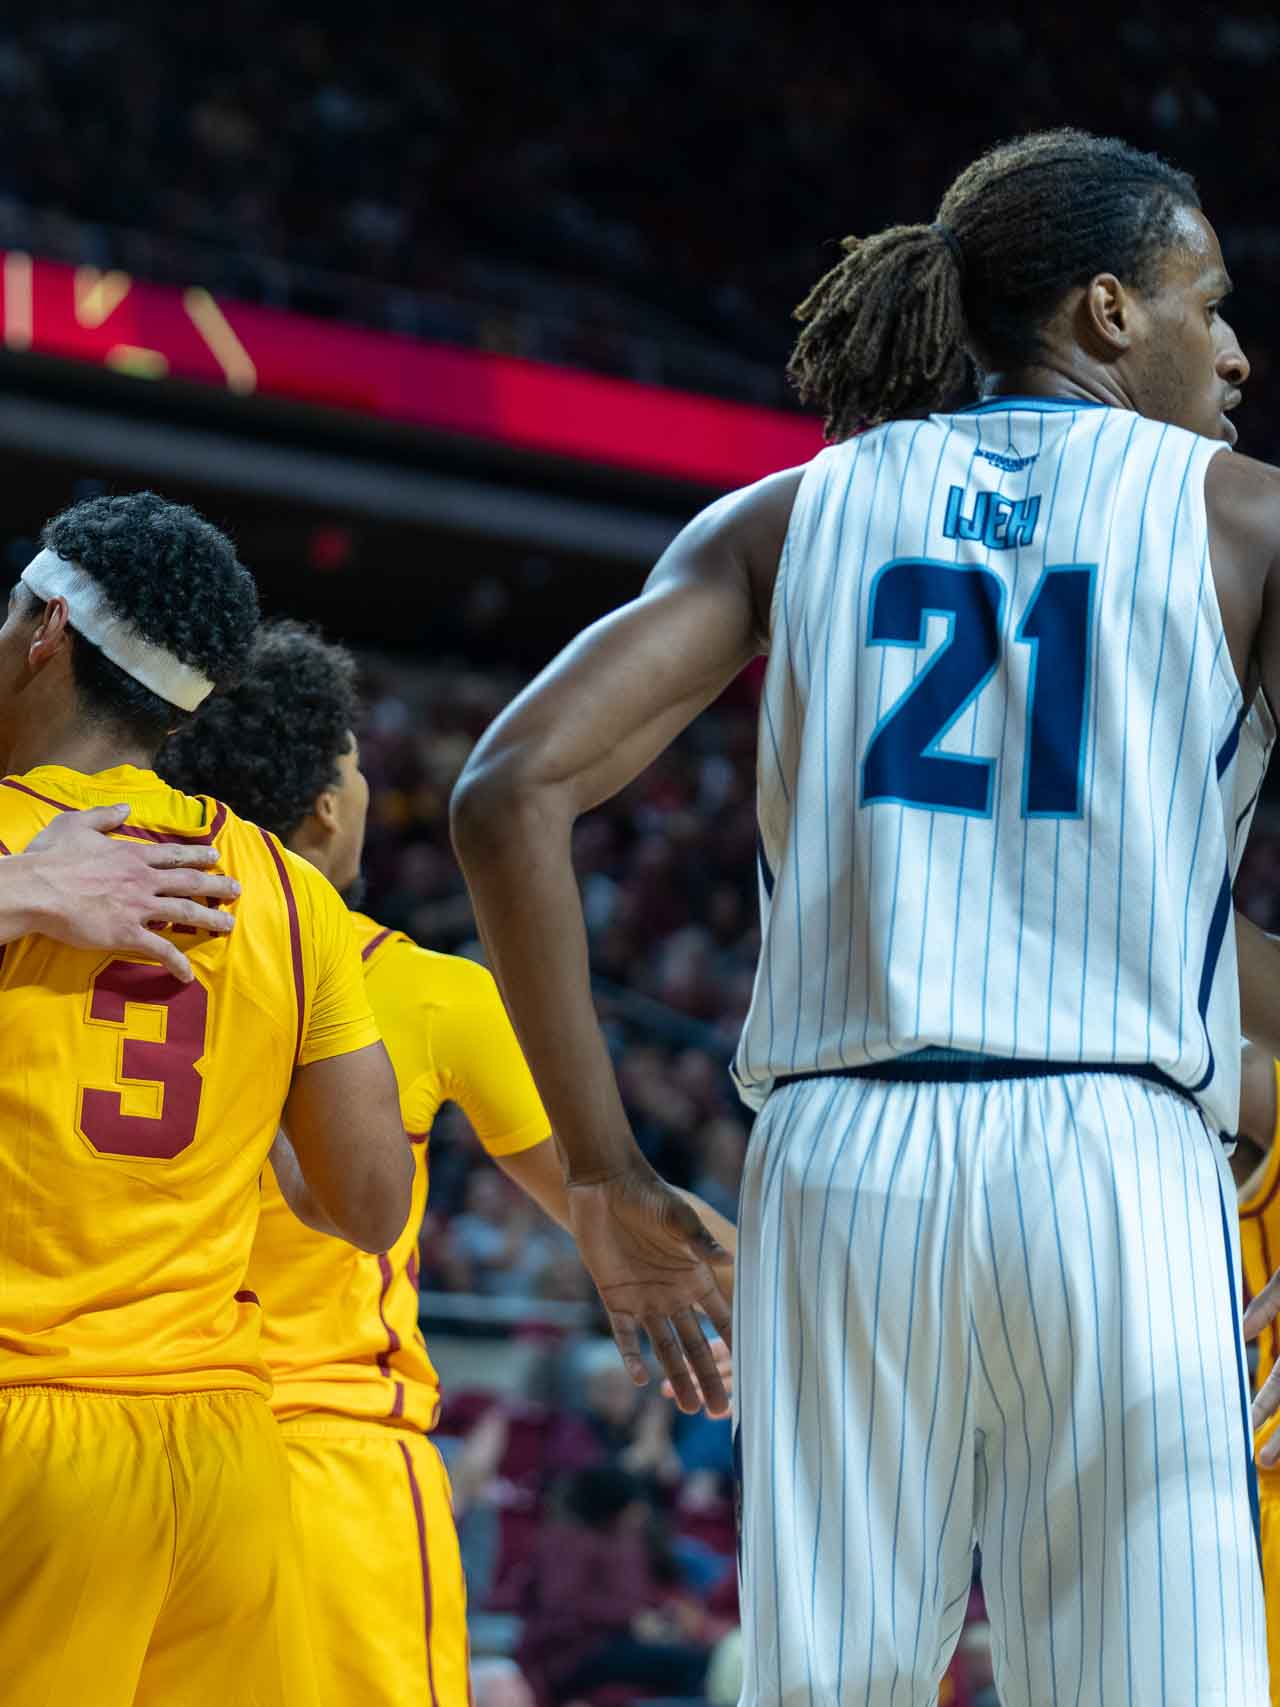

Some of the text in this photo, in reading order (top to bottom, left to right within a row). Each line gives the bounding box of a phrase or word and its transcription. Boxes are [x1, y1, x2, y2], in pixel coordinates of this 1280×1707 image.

[943, 485, 1042, 549] IJEH
[860, 557, 1098, 819] 21
[75, 956, 210, 1162] 3
